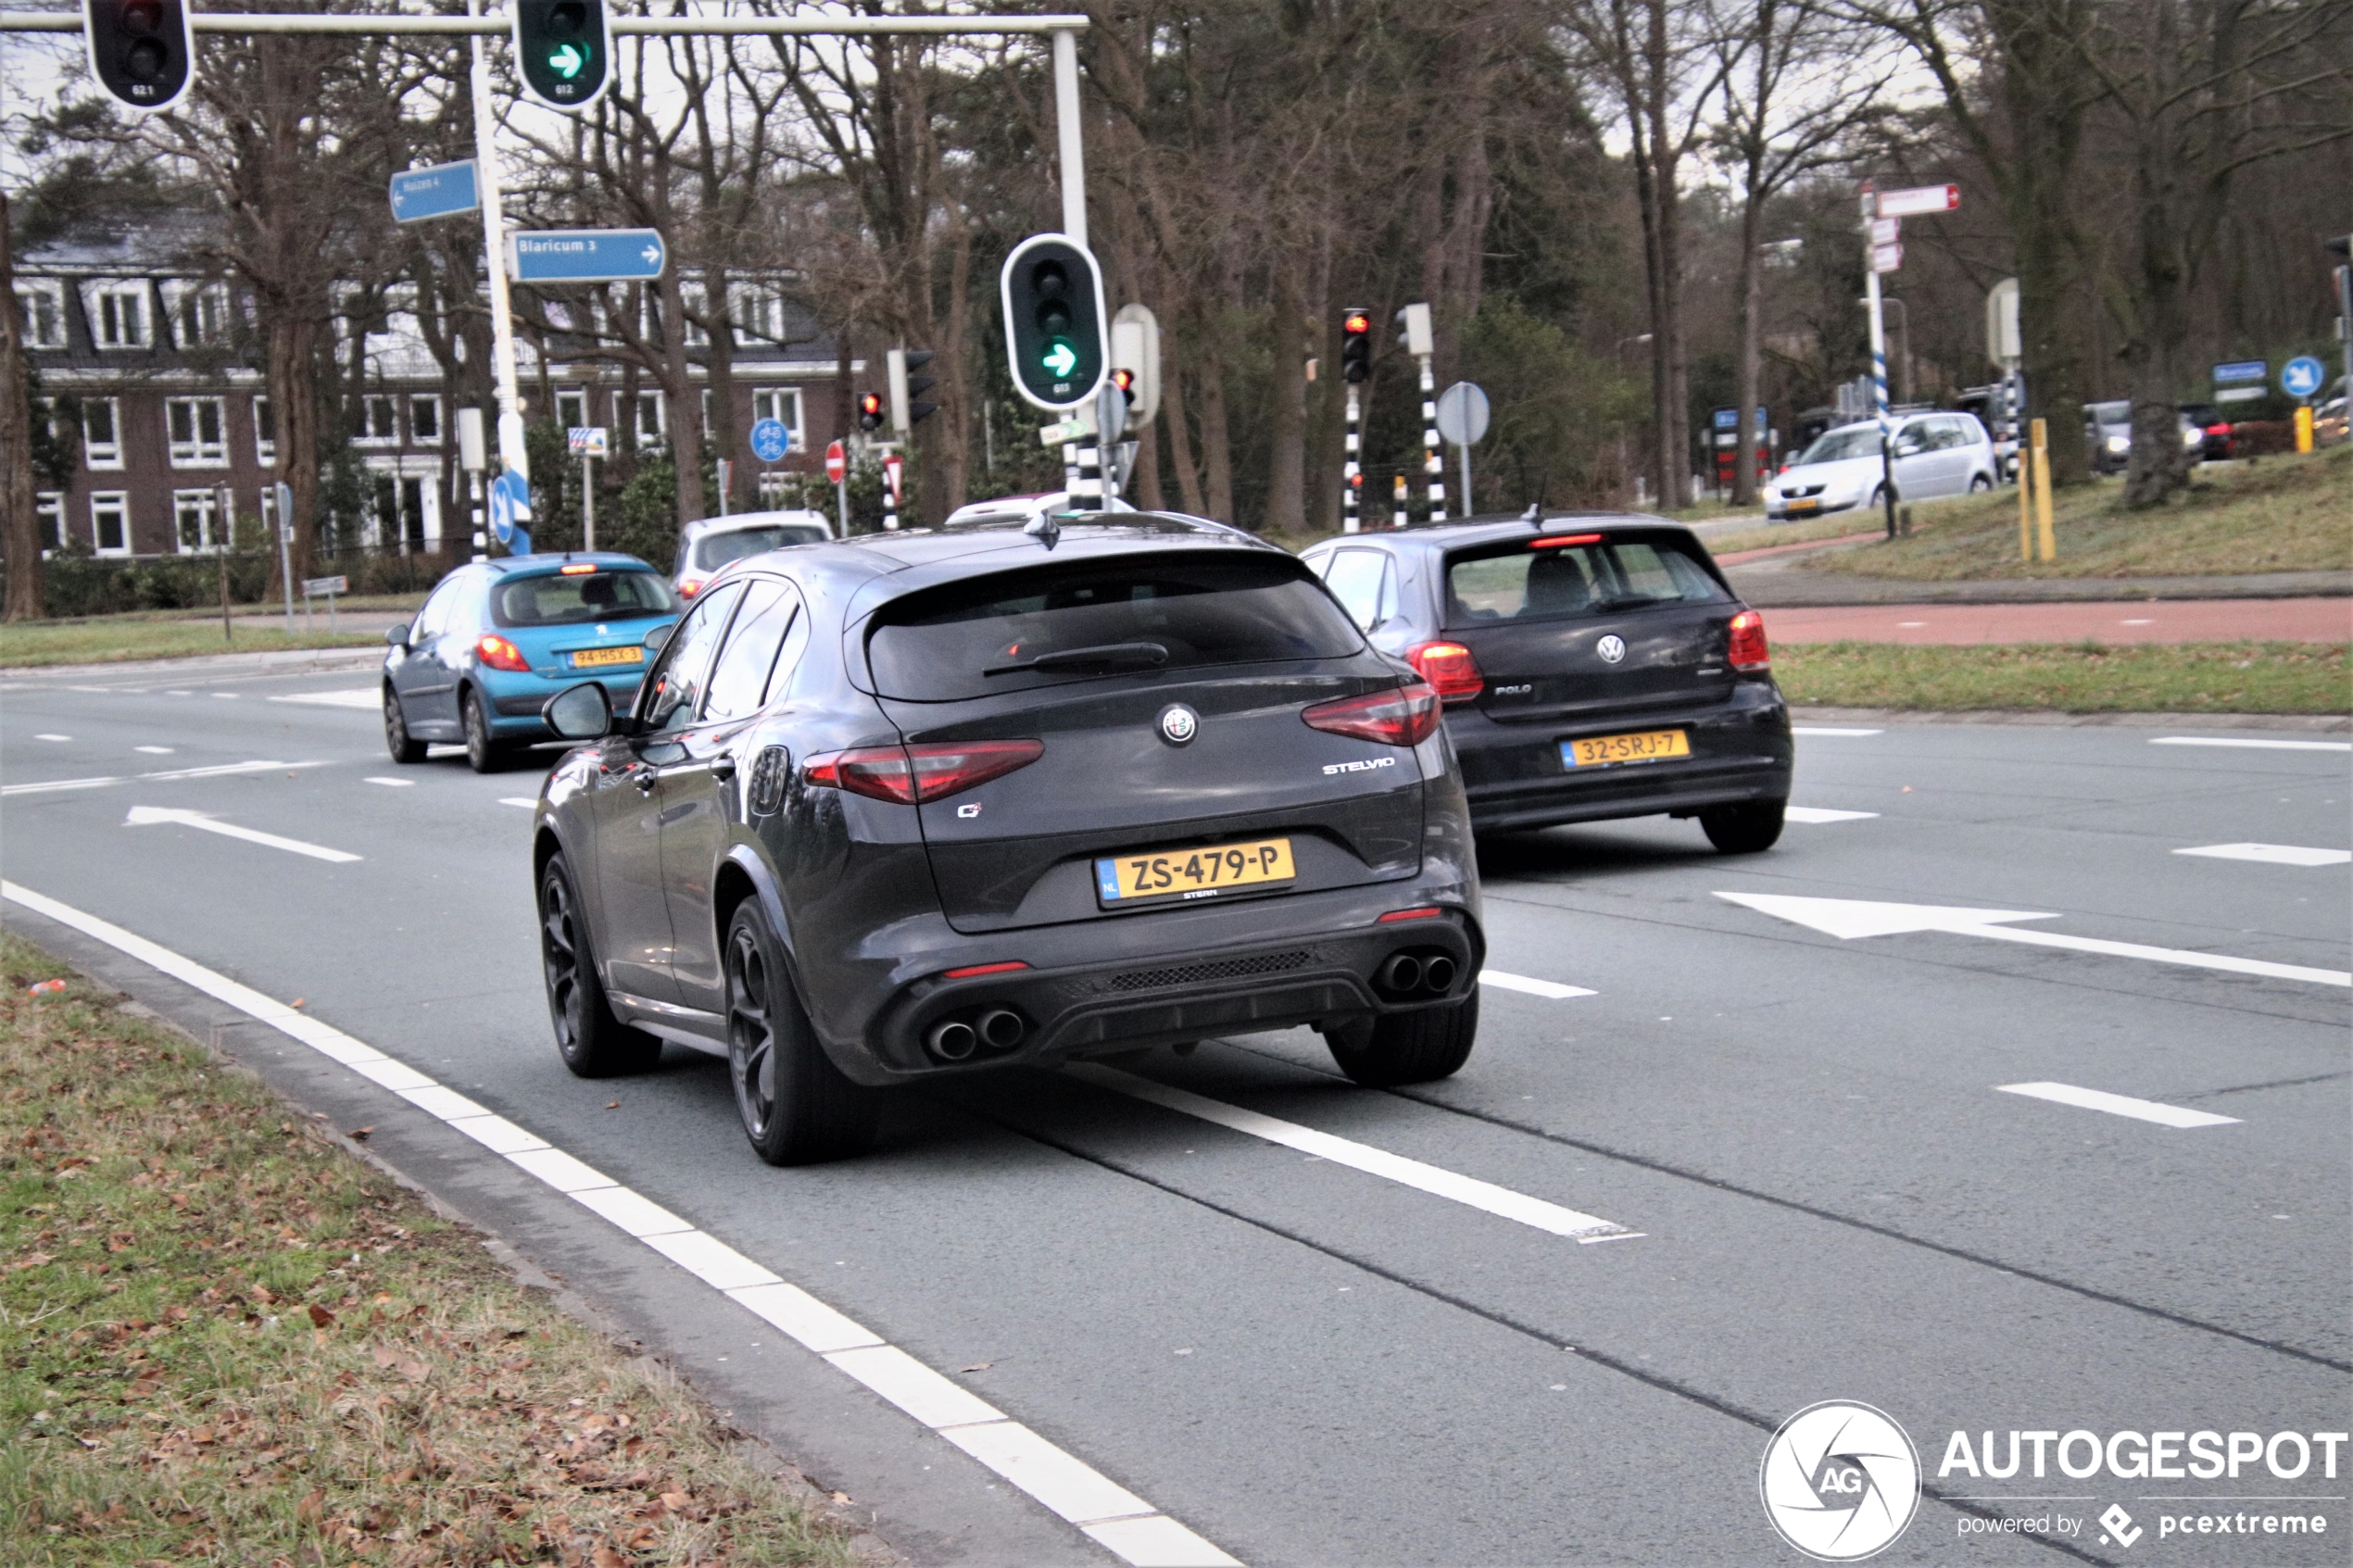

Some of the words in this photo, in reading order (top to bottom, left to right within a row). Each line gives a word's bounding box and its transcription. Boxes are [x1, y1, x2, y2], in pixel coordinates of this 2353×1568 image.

[132, 84, 155, 95] 621
[555, 83, 573, 94] 612
[519, 239, 584, 253] Blaricum
[587, 240, 596, 251] 3
[577, 648, 638, 663] 94-HSX-3
[1495, 684, 1532, 696] POLO
[1582, 734, 1675, 760] 32-SRJ-7
[1322, 757, 1396, 775] STELVIO
[1131, 846, 1278, 891] ZS-479-P
[1103, 883, 1117, 893] NL
[1183, 889, 1217, 899] STERN
